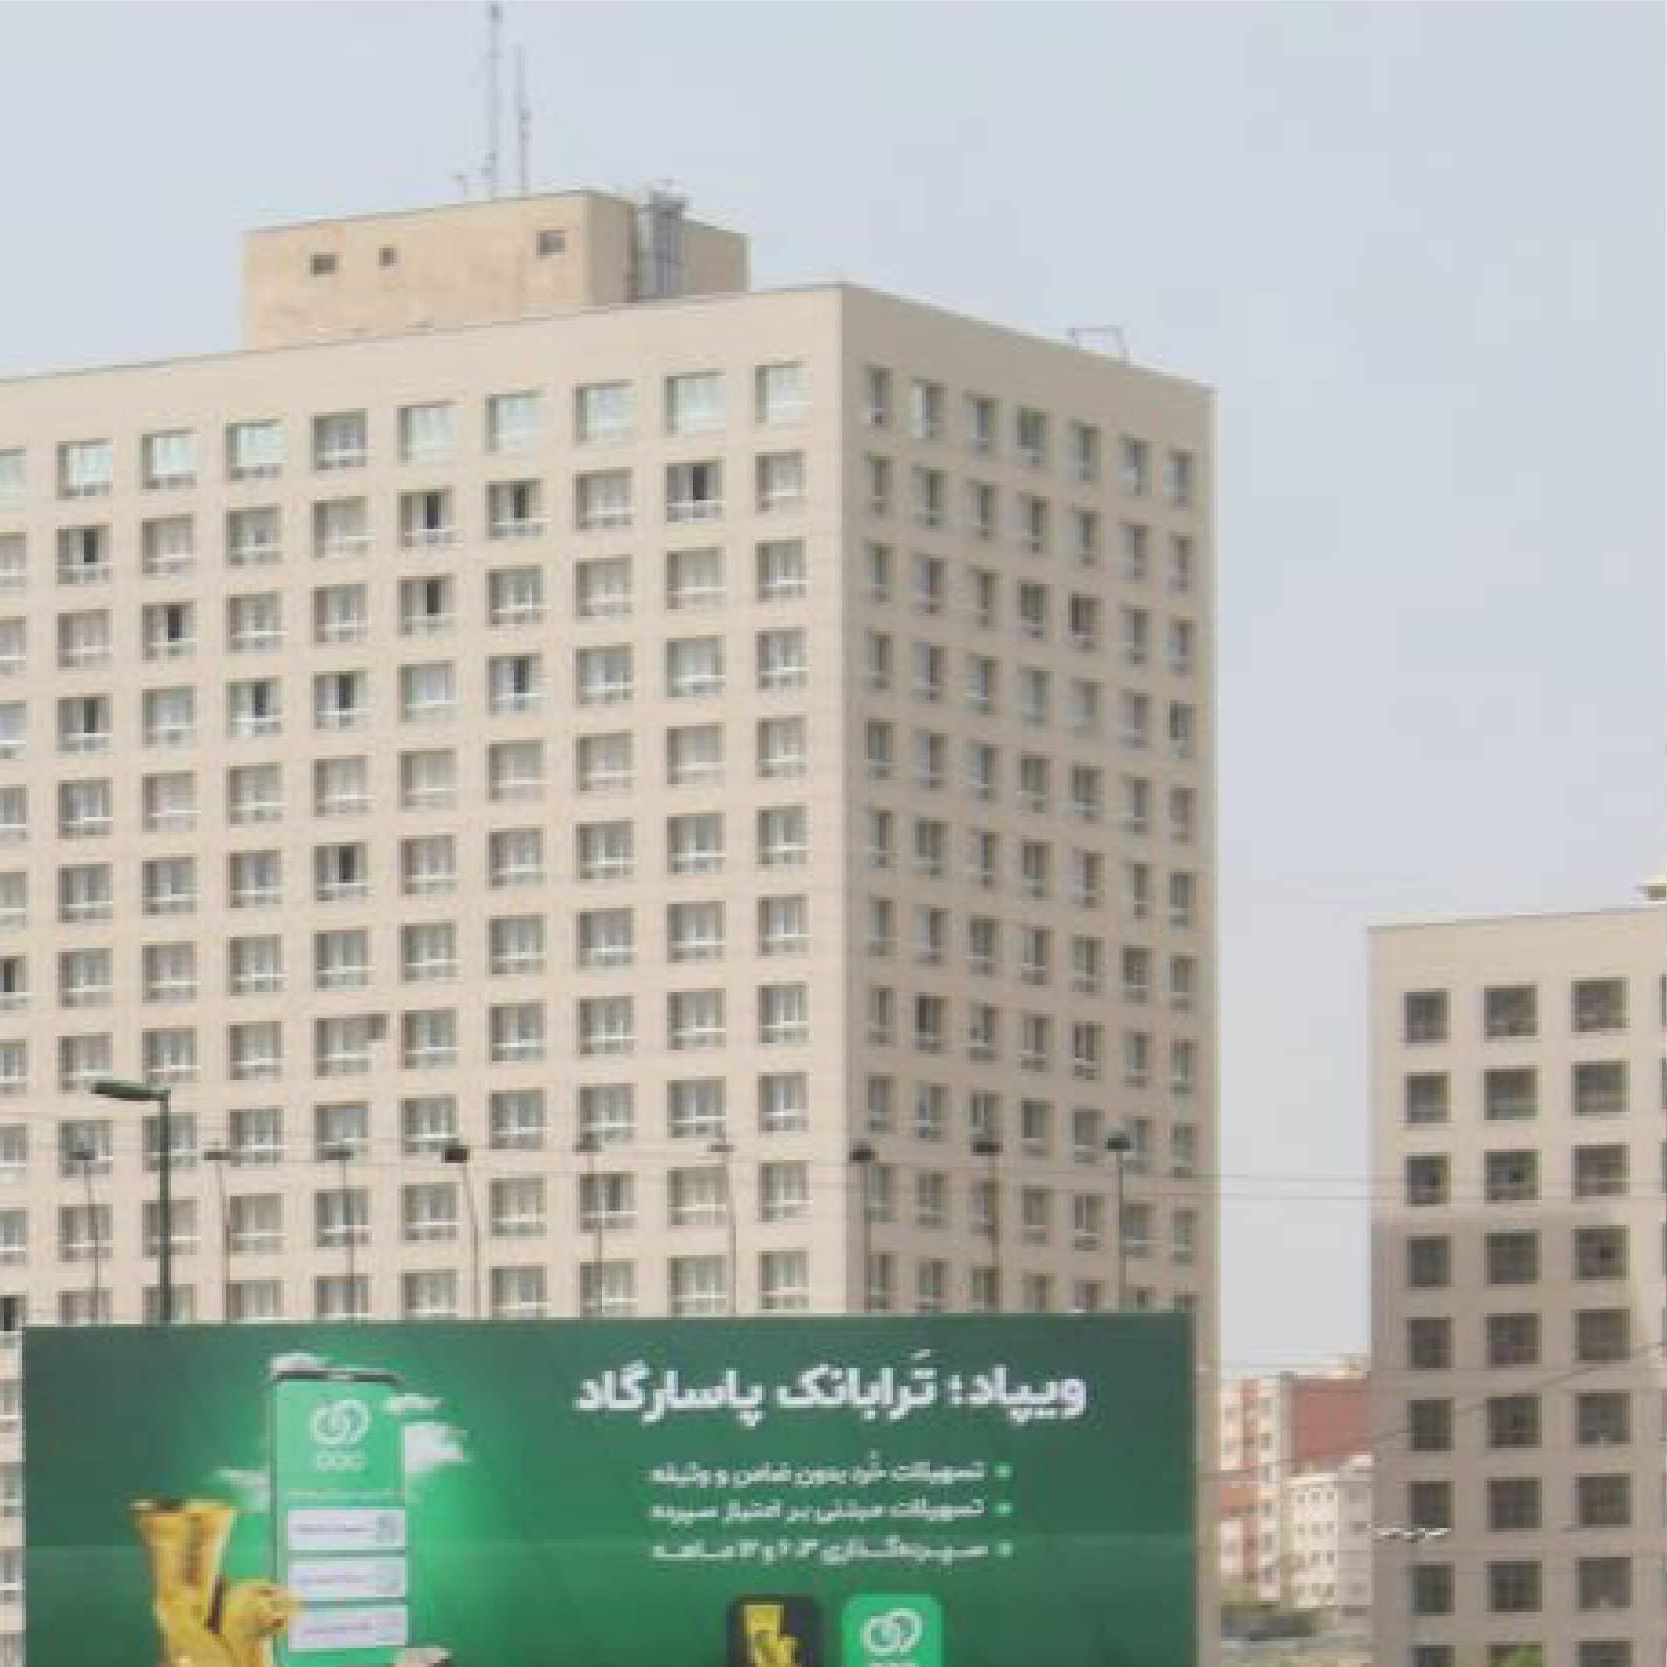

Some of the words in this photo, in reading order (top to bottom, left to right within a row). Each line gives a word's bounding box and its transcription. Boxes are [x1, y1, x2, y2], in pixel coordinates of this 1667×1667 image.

[577, 1360, 763, 1427] پاسارگاد
[891, 1461, 985, 1484] تسهیلات
[890, 1497, 985, 1522] تسهیلات
